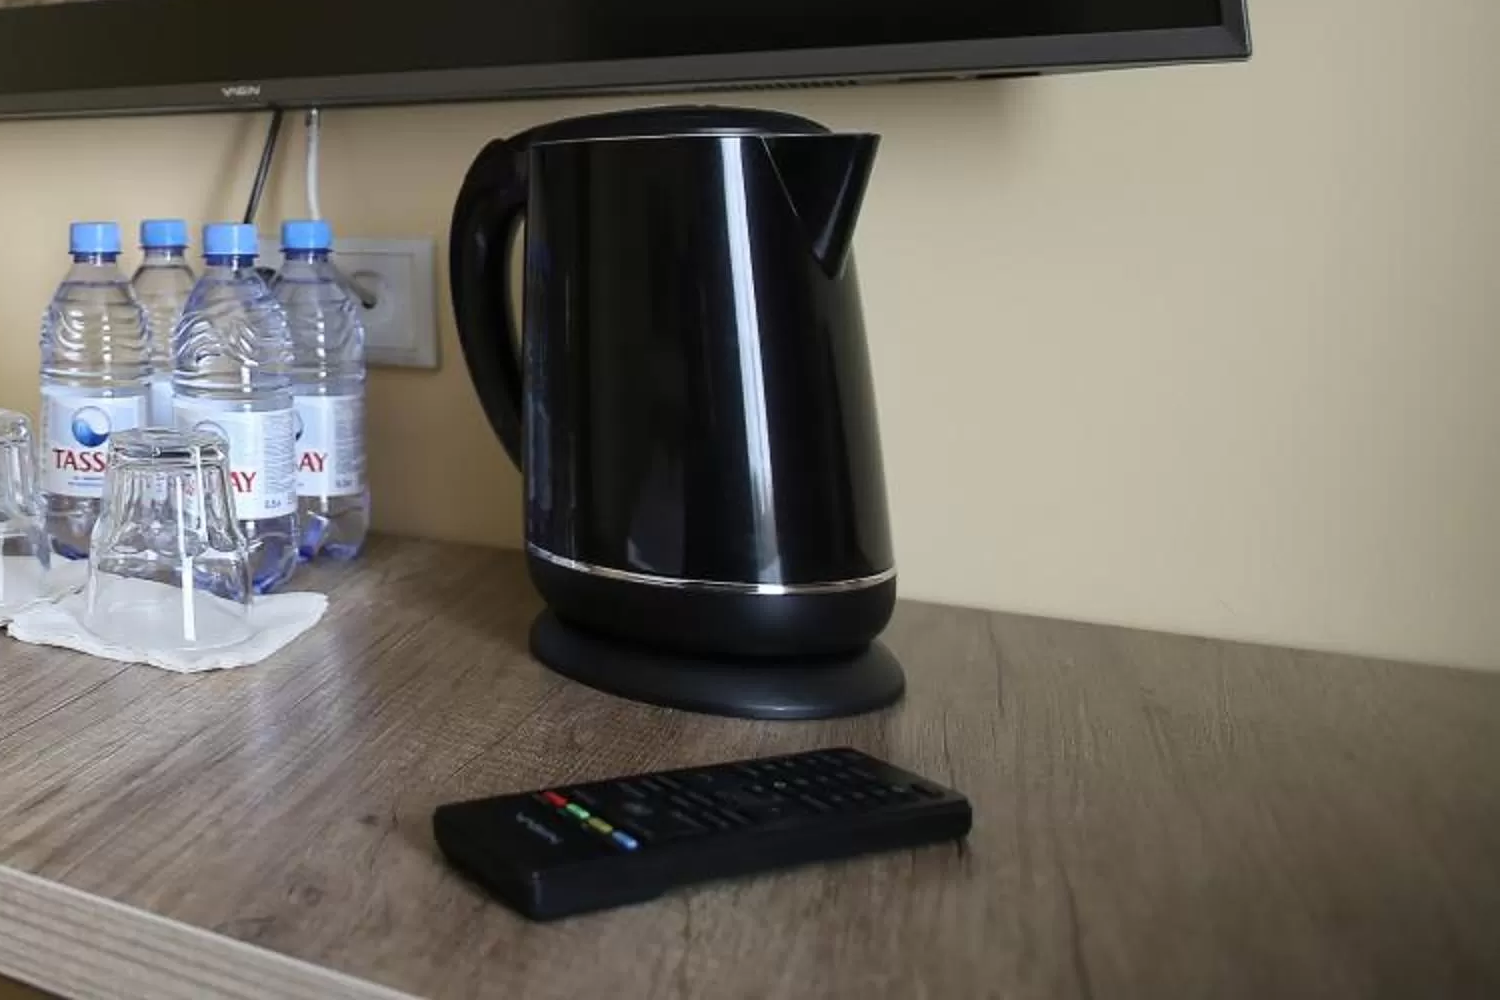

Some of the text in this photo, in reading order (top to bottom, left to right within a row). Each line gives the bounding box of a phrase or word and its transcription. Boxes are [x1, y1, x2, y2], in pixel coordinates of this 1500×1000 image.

[52, 447, 106, 473] TASS
[298, 451, 329, 473] AY
[229, 471, 257, 493] AY
